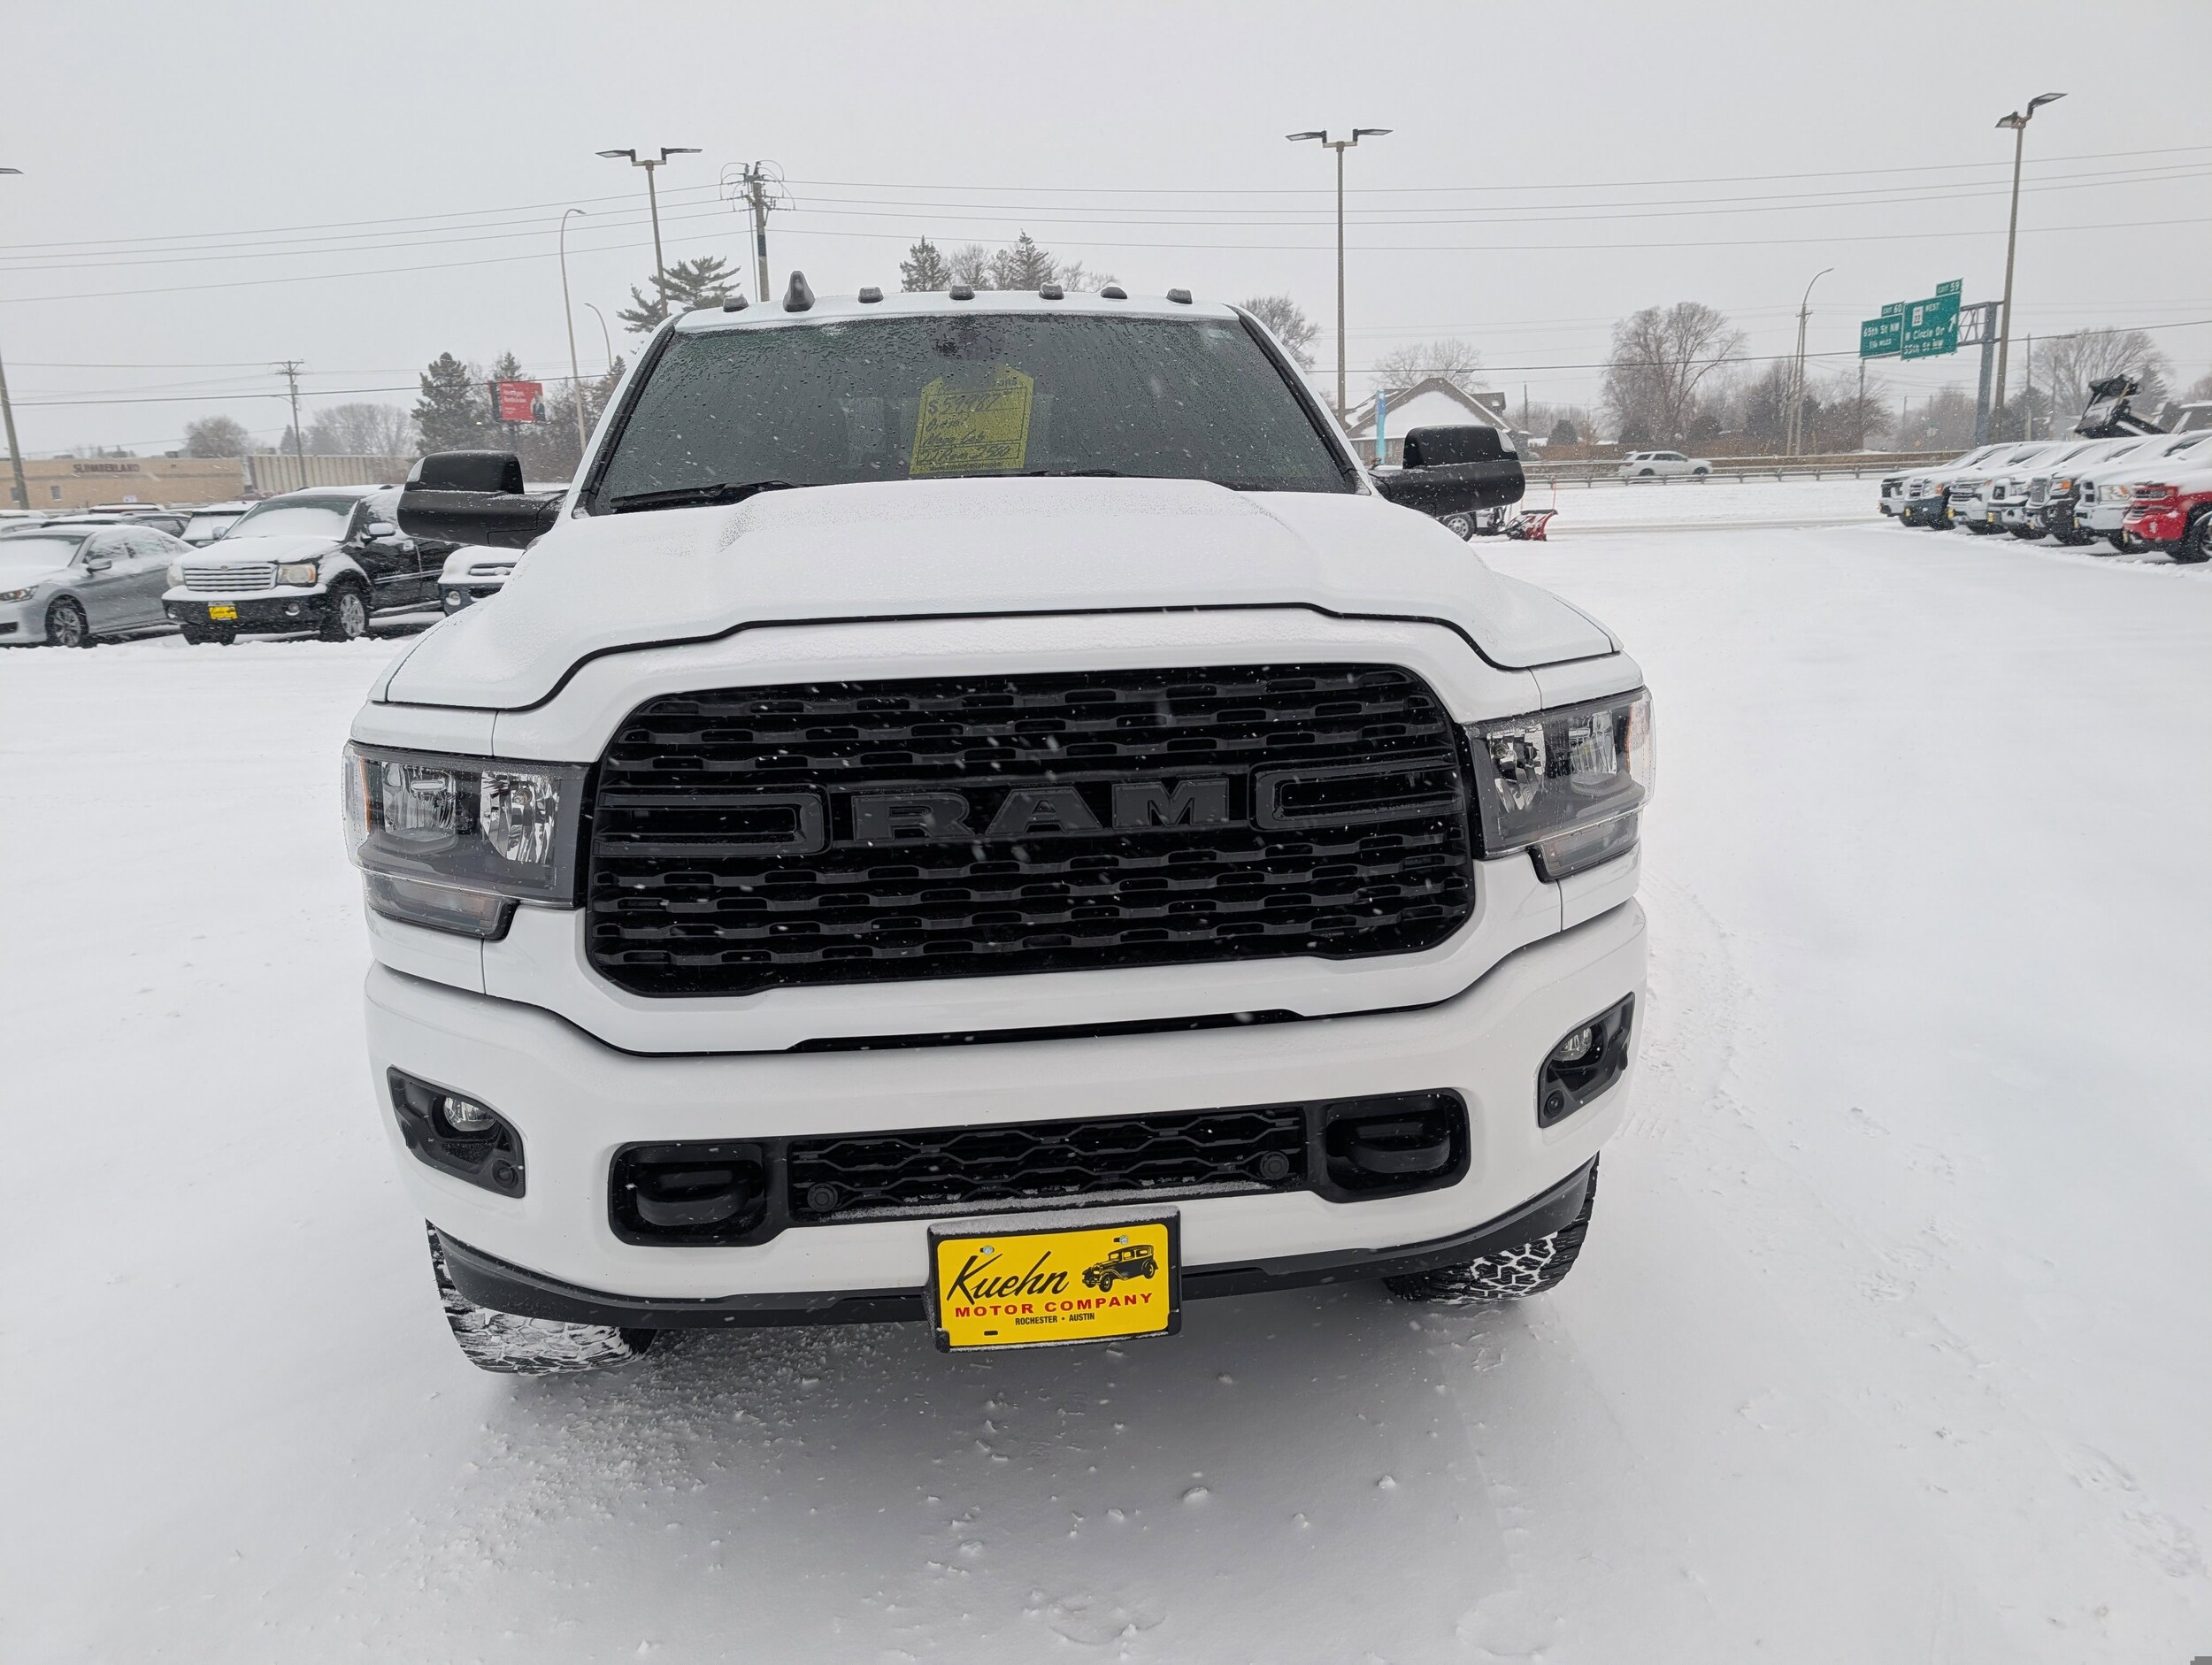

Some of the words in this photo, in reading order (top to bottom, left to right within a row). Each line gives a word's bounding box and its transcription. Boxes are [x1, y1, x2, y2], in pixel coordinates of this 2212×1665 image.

[1949, 281, 1960, 292] 59
[1893, 303, 1902, 314] 60
[1924, 303, 1940, 312] WEST
[1914, 314, 1921, 324] 22
[1863, 326, 1878, 338] 65th
[1880, 325, 1889, 334] St
[1890, 322, 1900, 332] NW
[1913, 327, 1932, 340] Circle
[1935, 326, 1945, 337] Dr
[1903, 343, 1920, 355] 55th
[1922, 341, 1931, 352] St
[1932, 340, 1944, 350] NW
[73, 464, 140, 472] SLUMBERLAND
[851, 778, 1229, 841] RAM
[946, 1250, 1070, 1305] Kuehn
[955, 1302, 1034, 1317] MOTOR
[1044, 1293, 1153, 1312] COMPANY
[1015, 1315, 1058, 1325] ROCHESTER
[1068, 1312, 1095, 1323] AUSTIN
